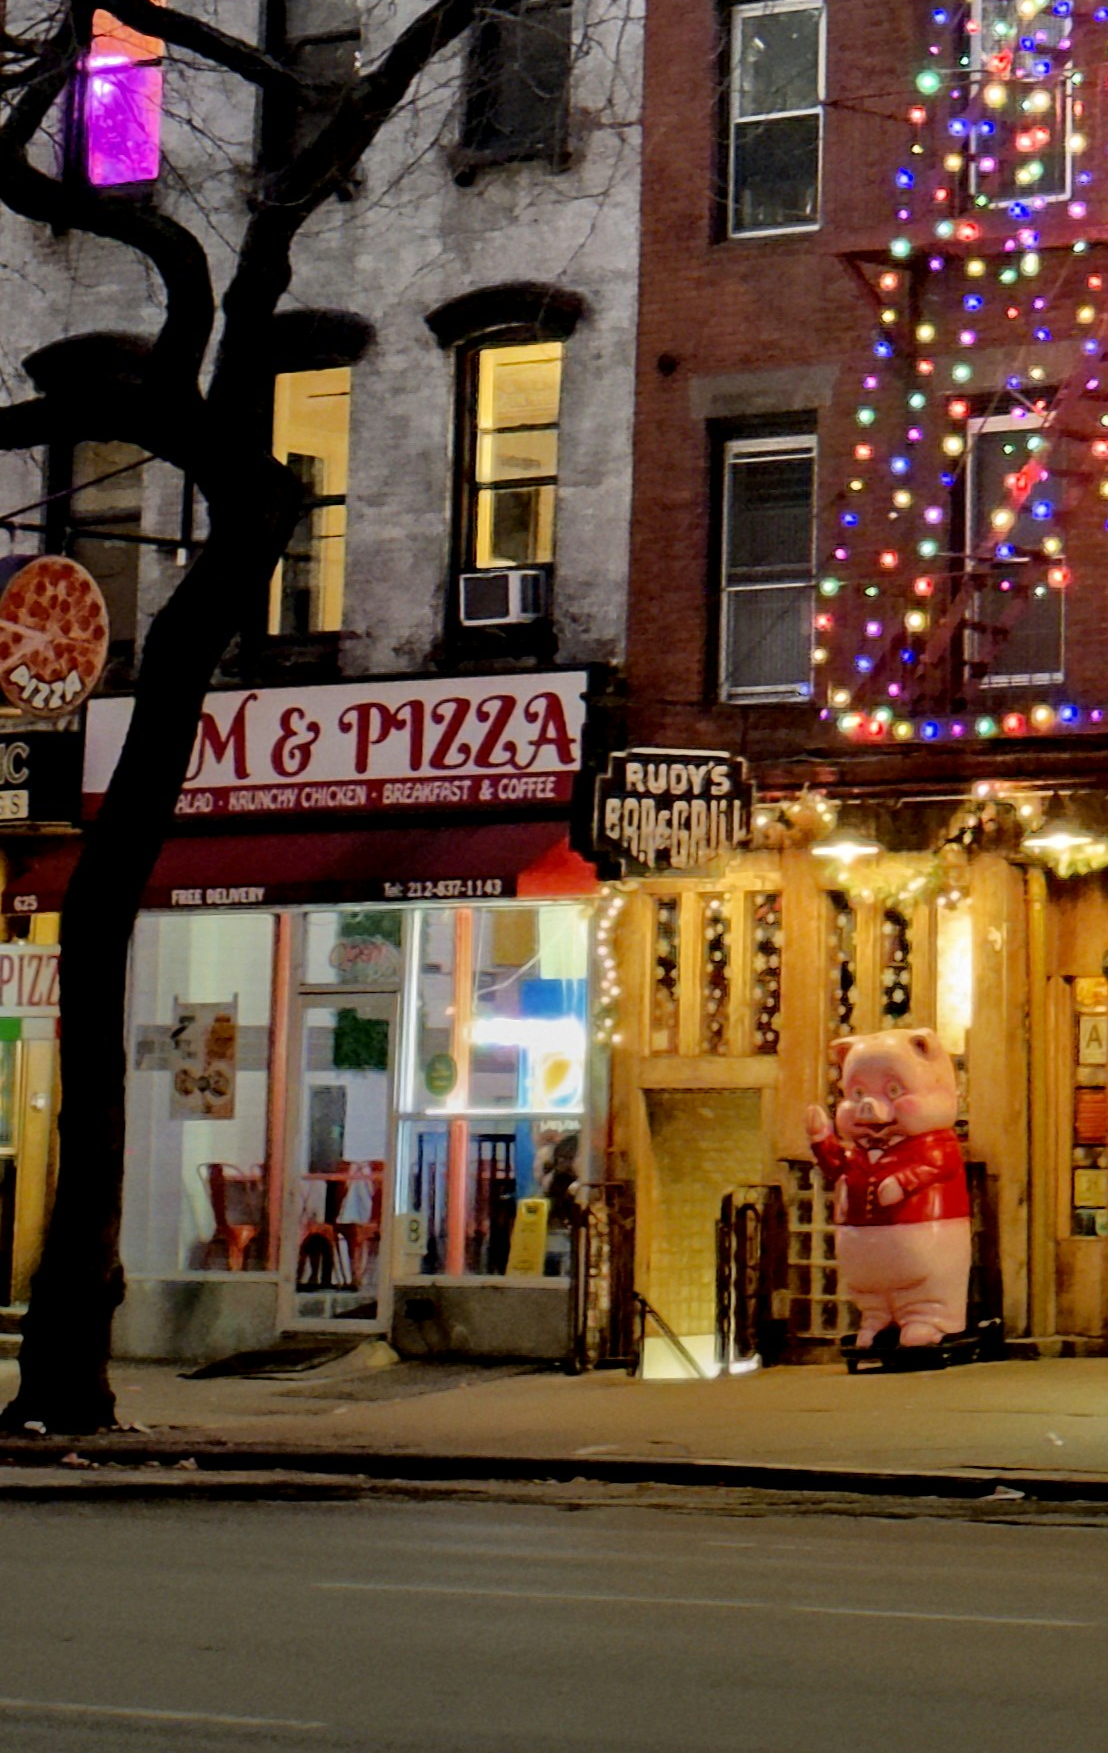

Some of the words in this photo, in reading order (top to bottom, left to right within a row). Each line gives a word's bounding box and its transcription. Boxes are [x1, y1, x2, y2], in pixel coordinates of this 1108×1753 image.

[10, 664, 83, 710] PIZZA
[270, 706, 321, 778] &
[338, 691, 577, 774] PIZZA
[173, 792, 213, 815] ALAD
[228, 787, 298, 812] KRUNCHY
[301, 784, 368, 809] CHICKEN
[382, 779, 472, 805] BREAKFAST
[478, 778, 495, 801] &
[497, 775, 557, 800] COFFEE
[625, 761, 731, 796] RUDY'S
[171, 889, 203, 906] FREE
[206, 886, 266, 905] DELIVERY
[0, 953, 60, 1006] PIZZ
[1085, 1023, 1103, 1050] A
